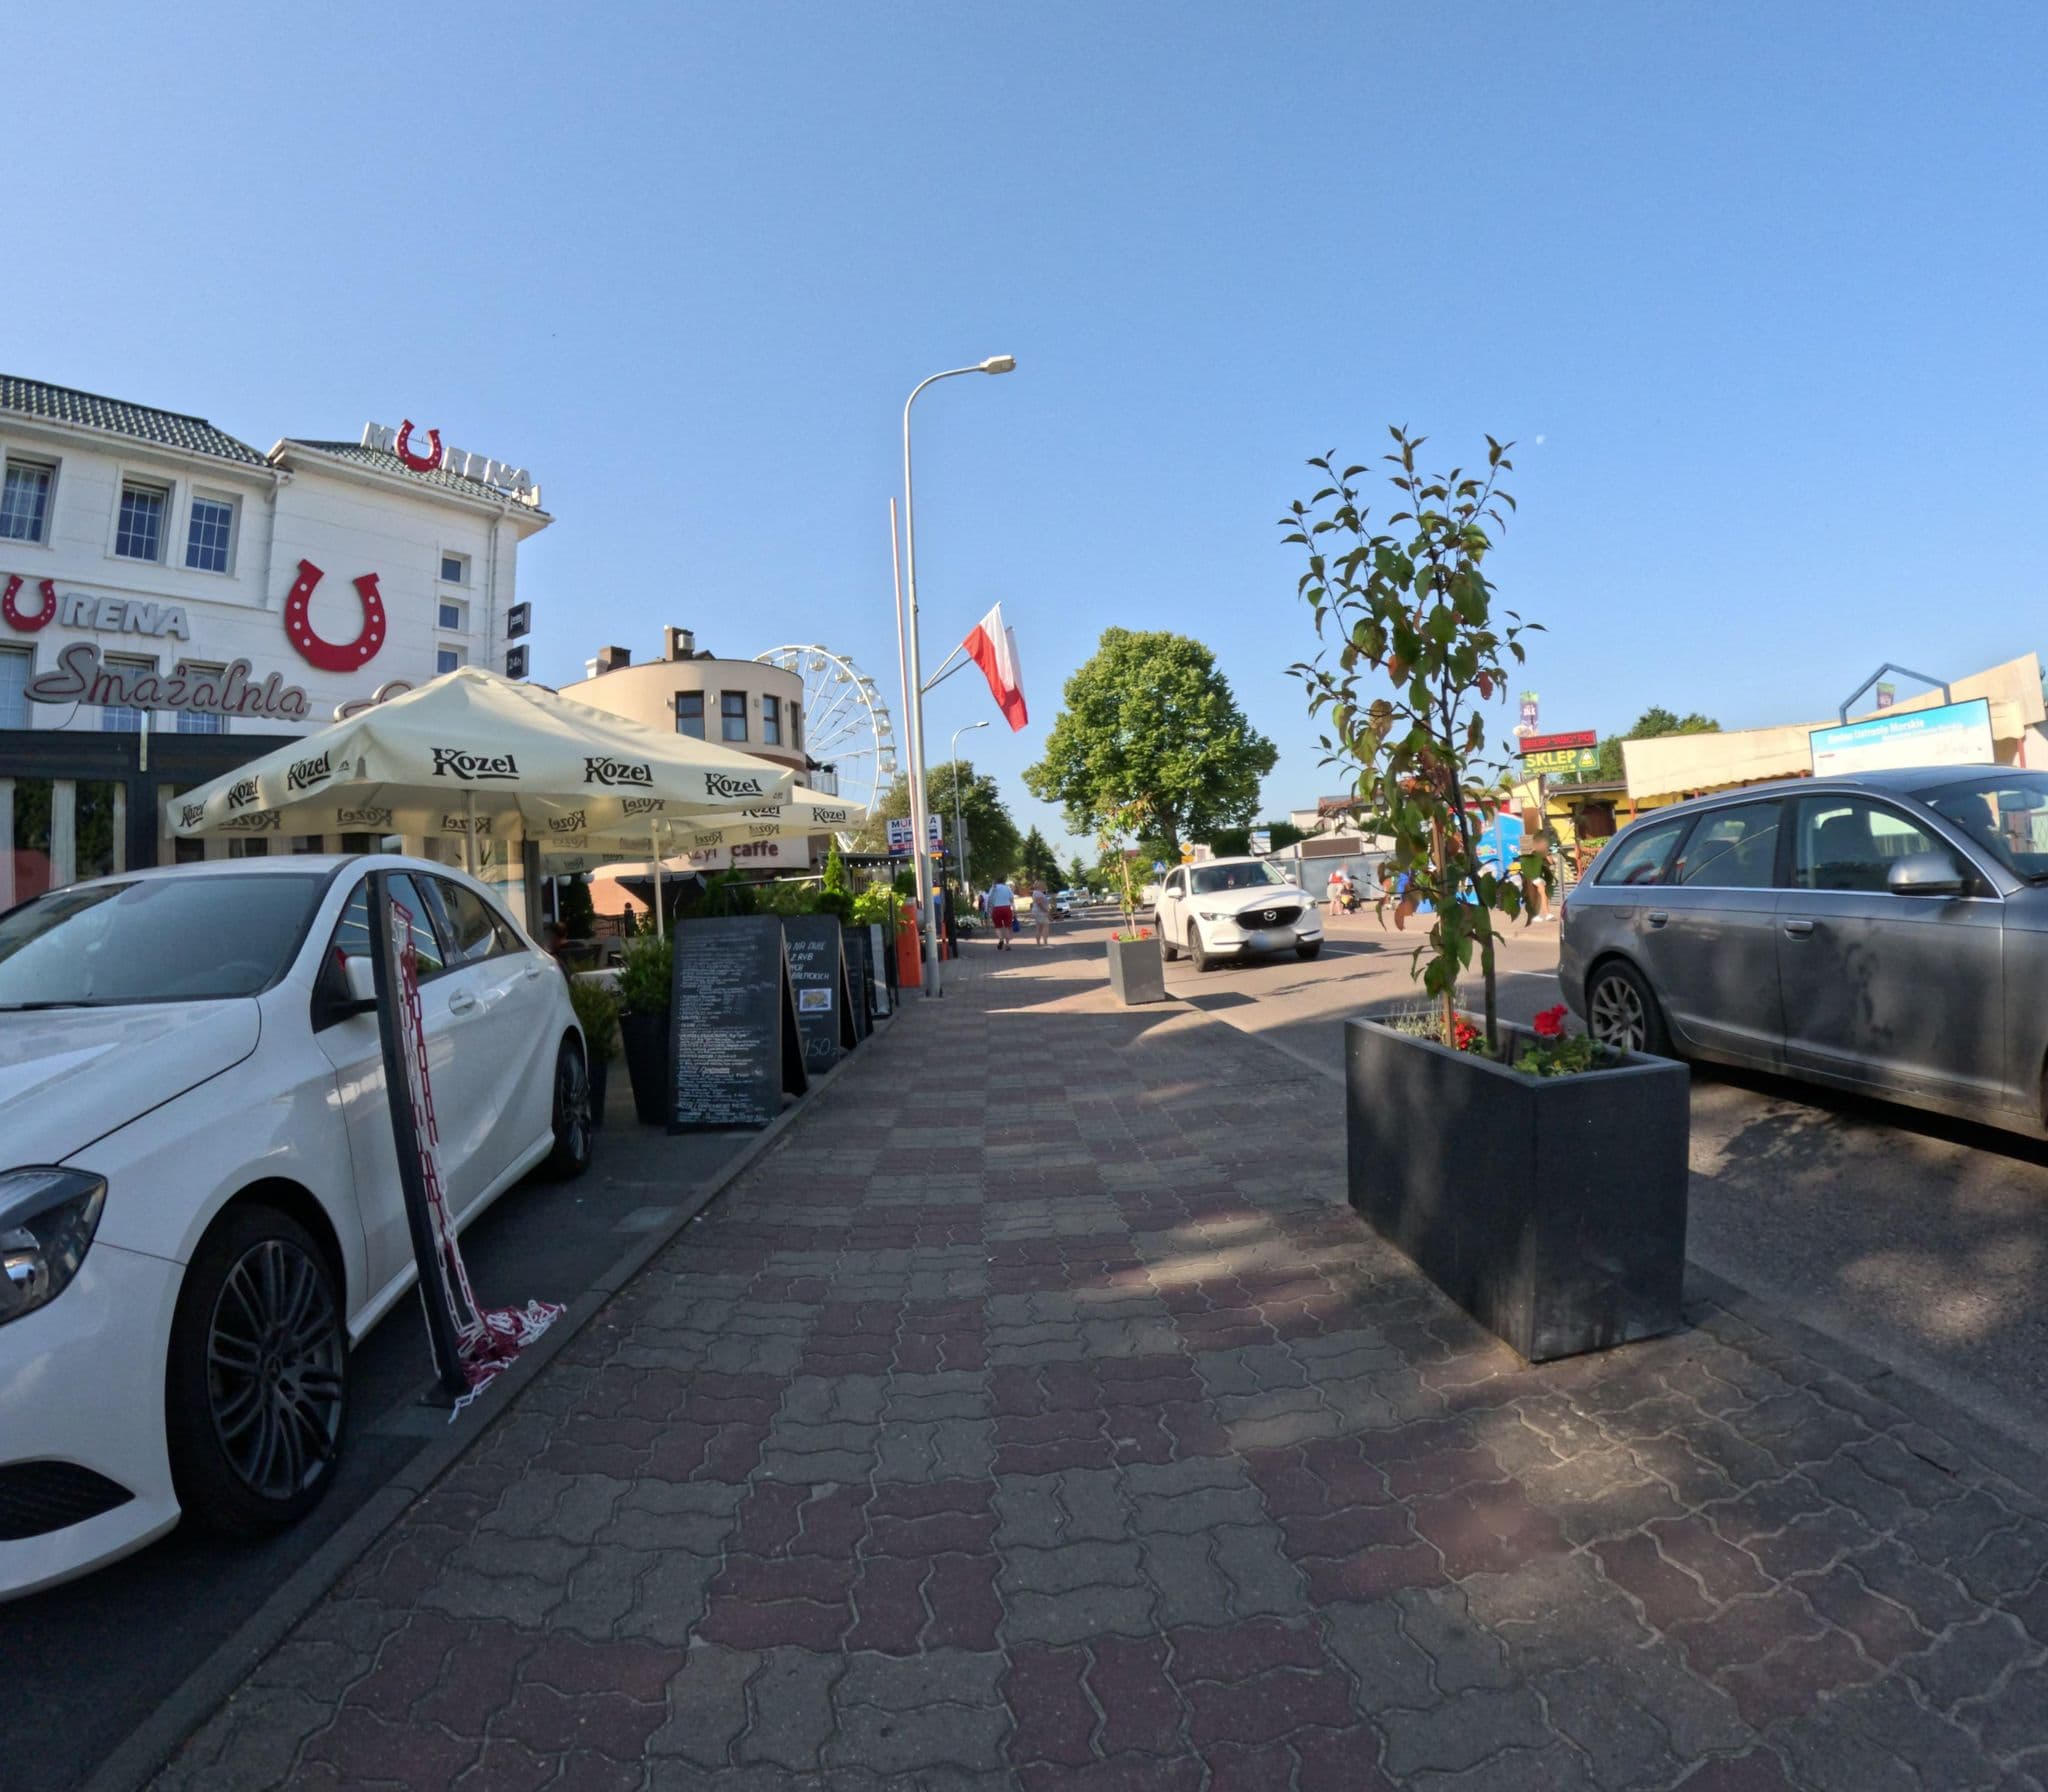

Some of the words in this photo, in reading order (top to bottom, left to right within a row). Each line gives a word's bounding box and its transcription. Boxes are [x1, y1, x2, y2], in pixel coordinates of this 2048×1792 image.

[287, 750, 331, 791] Kozel
[430, 748, 520, 780] Kozel
[1526, 749, 1577, 767] SKLEP
[584, 757, 654, 787] Kozel
[704, 773, 763, 798] Kozel
[228, 775, 260, 809] Kozel
[180, 800, 207, 827] Kozel
[812, 807, 847, 823] Kozel
[731, 840, 779, 858] caffe
